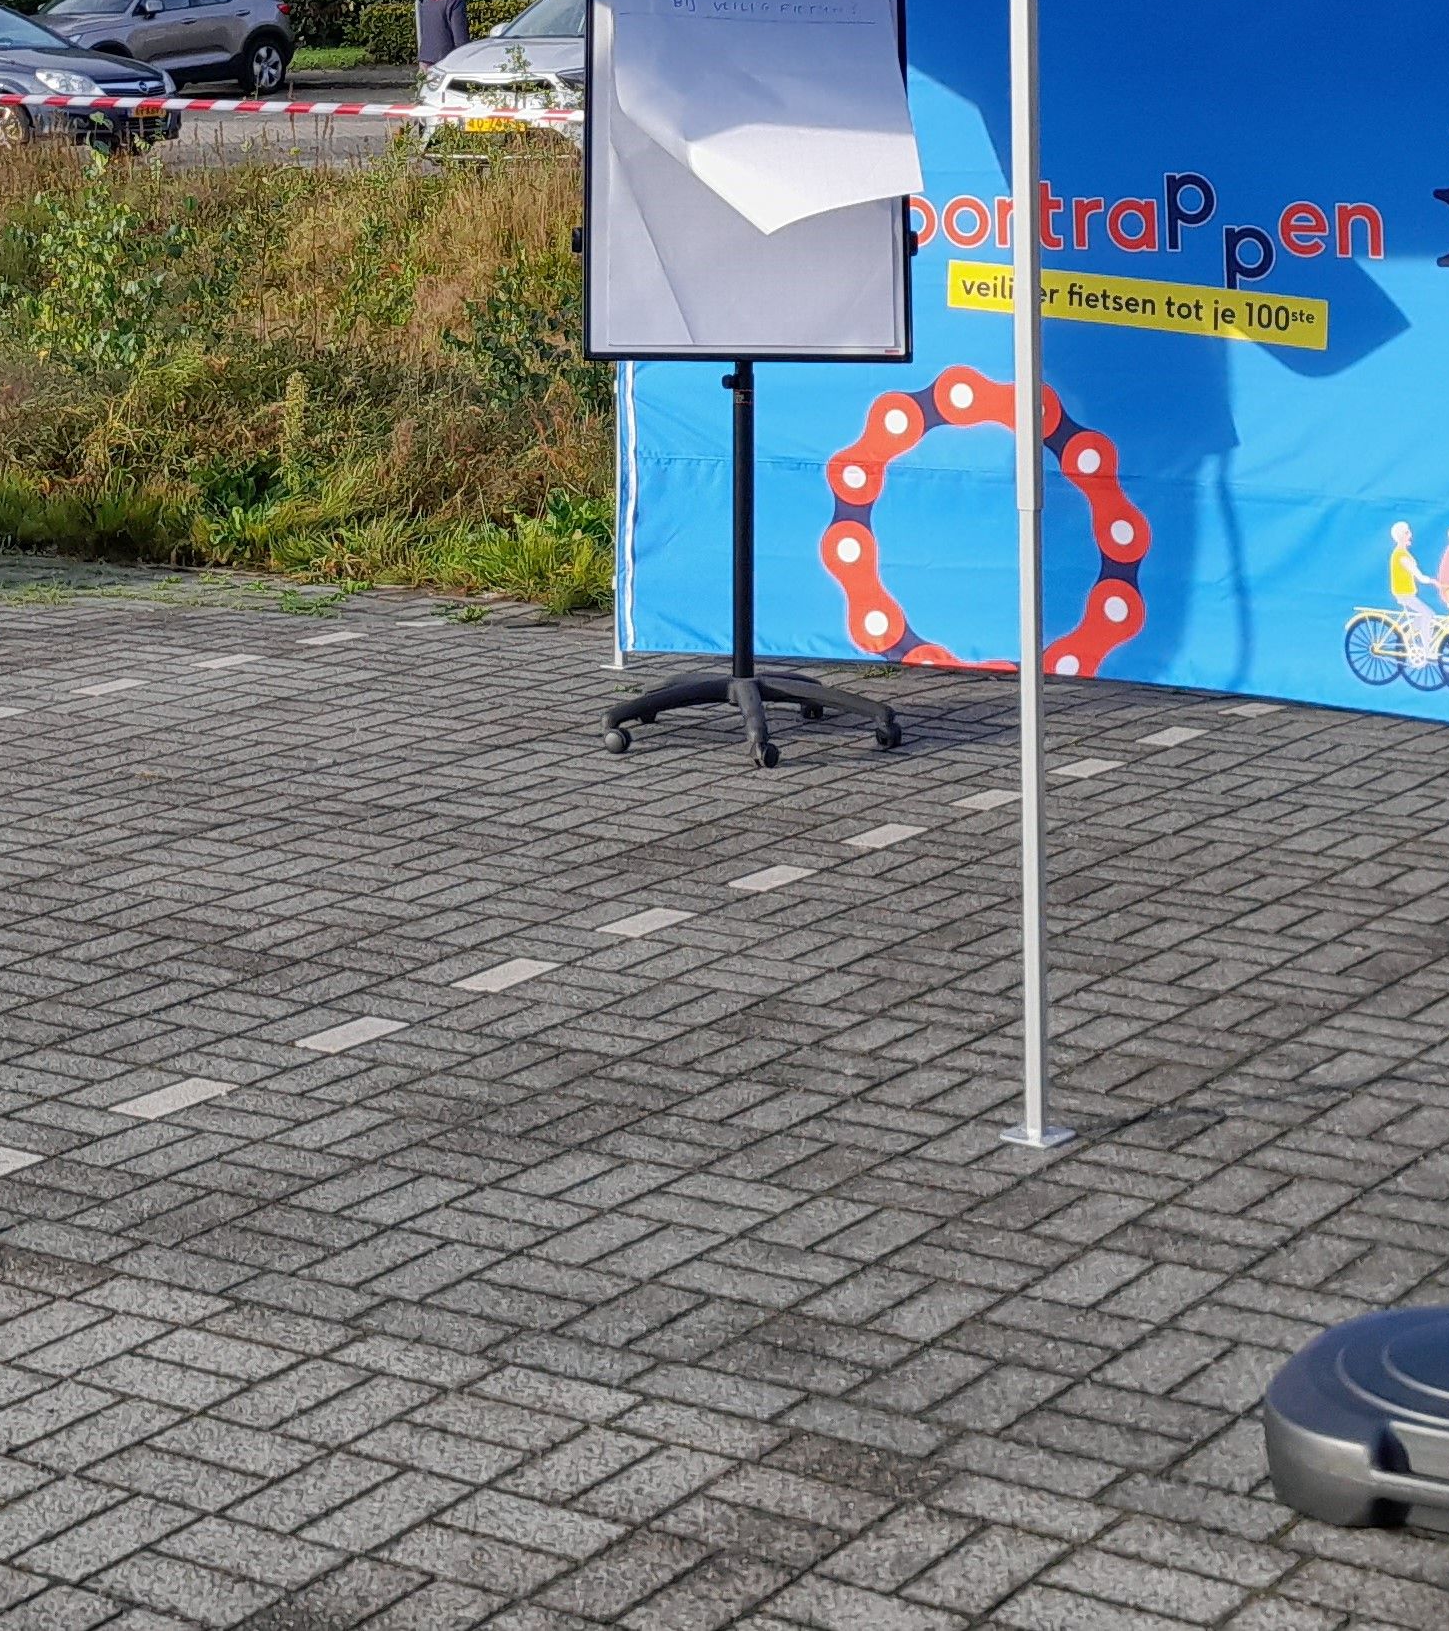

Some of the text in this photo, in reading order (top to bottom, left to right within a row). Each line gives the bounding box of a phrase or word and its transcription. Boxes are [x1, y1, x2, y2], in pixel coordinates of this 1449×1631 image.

[907, 171, 1384, 289] oortrappen
[961, 275, 1315, 331] veilier fietsen tot je 100ste
